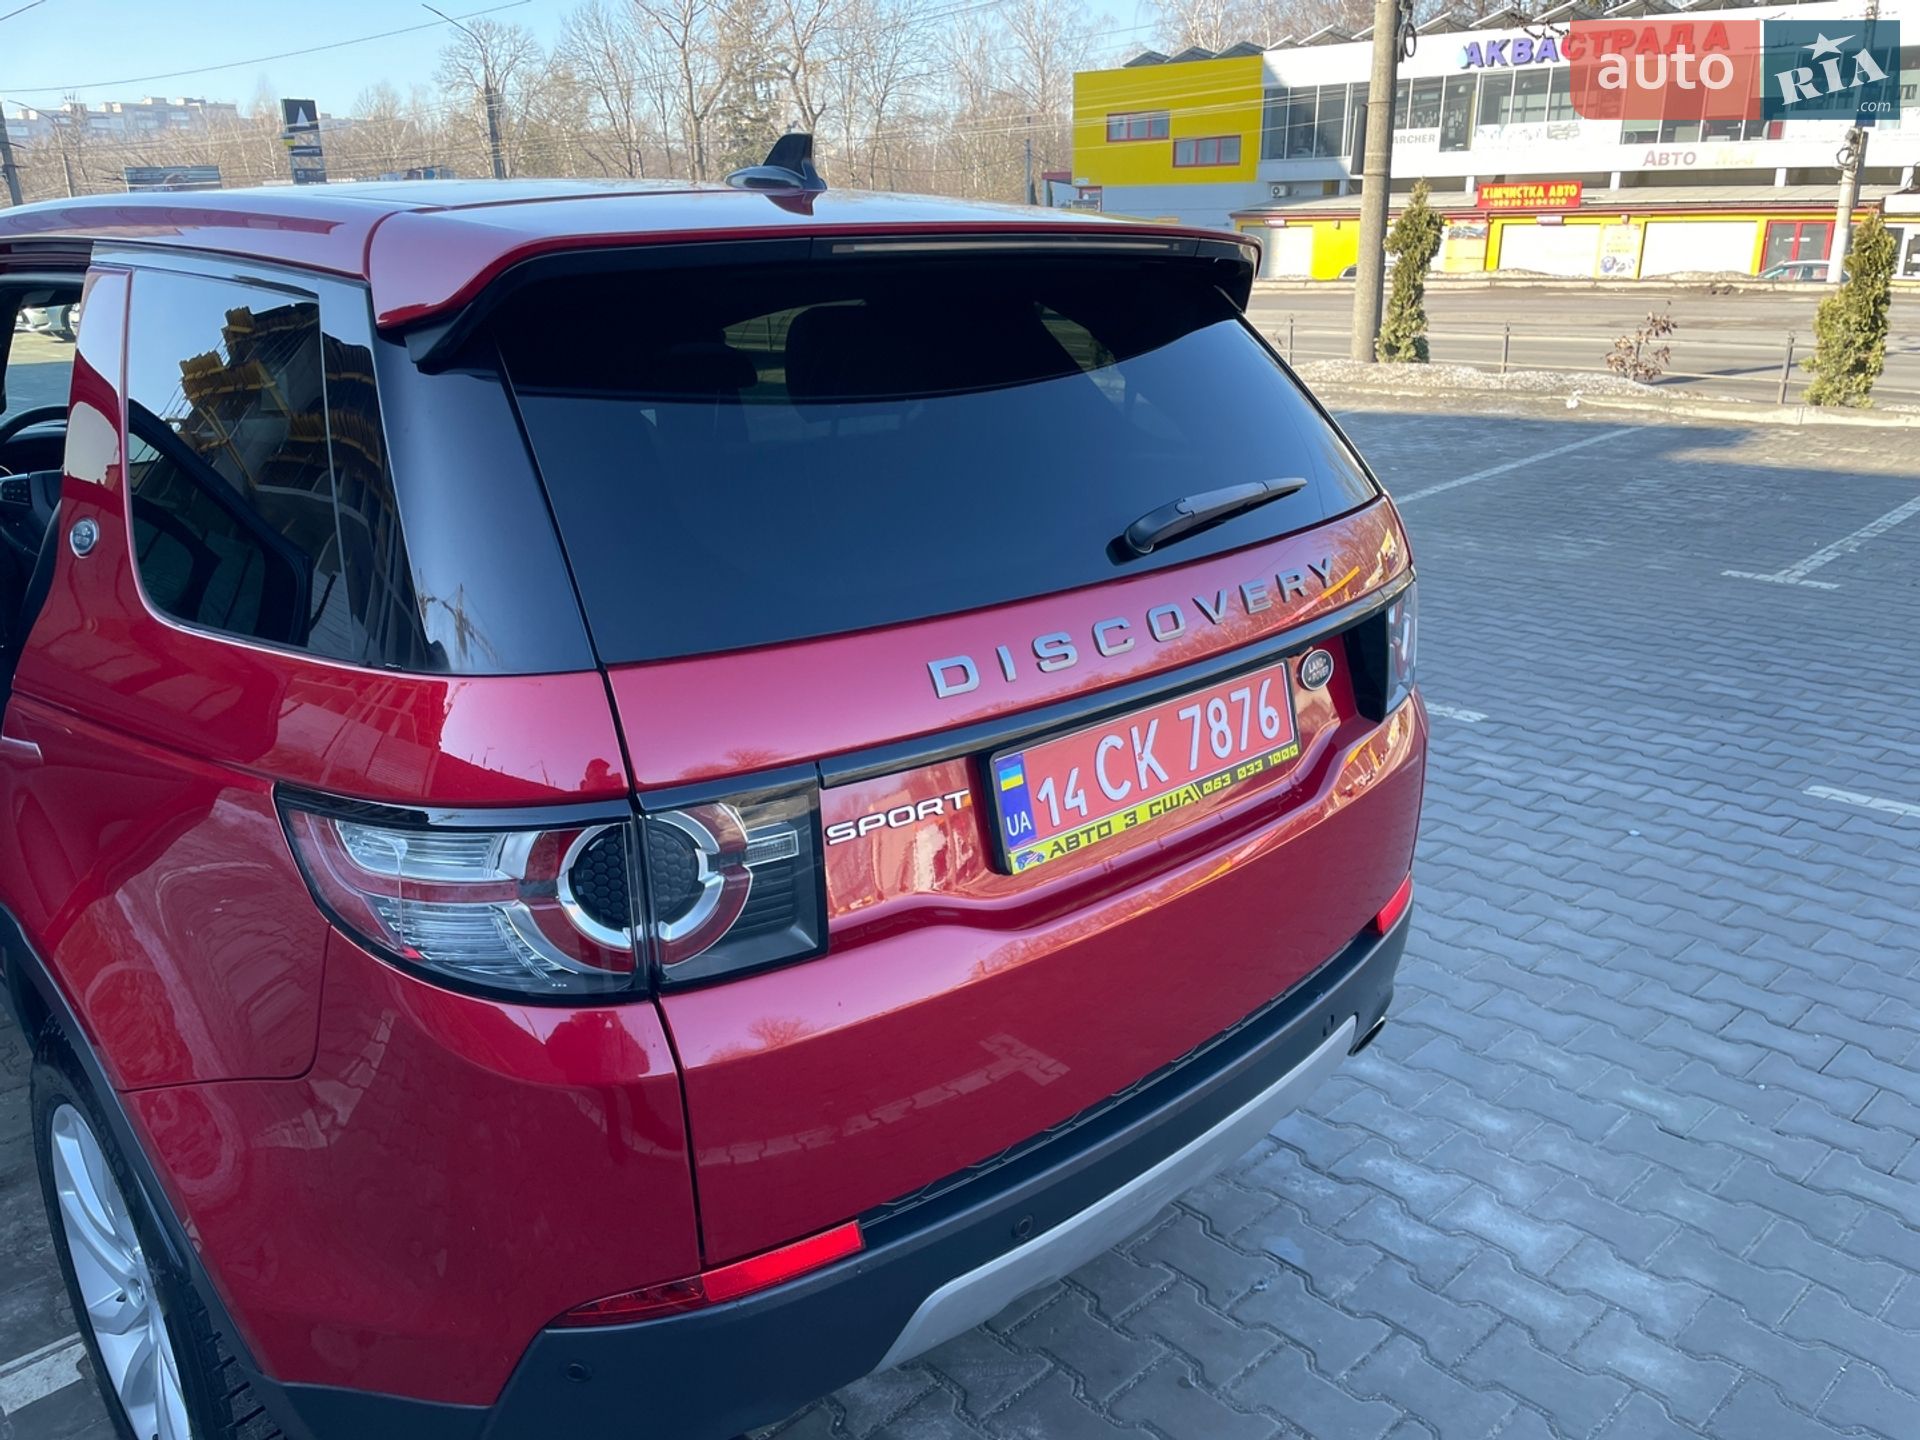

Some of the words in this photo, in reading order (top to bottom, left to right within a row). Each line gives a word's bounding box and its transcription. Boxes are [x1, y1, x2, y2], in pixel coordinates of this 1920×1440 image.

[1548, 184, 1578, 197] АВТО
[926, 555, 1337, 700] DISCOVERY
[1037, 767, 1088, 827] 14
[1178, 678, 1281, 772] 7876
[825, 789, 971, 846] SPORT
[1006, 811, 1032, 837] UA
[1050, 820, 1113, 858] АВТО
[1202, 774, 1231, 794] 063
[1237, 759, 1263, 780] 033
[1269, 744, 1299, 766] 1000
